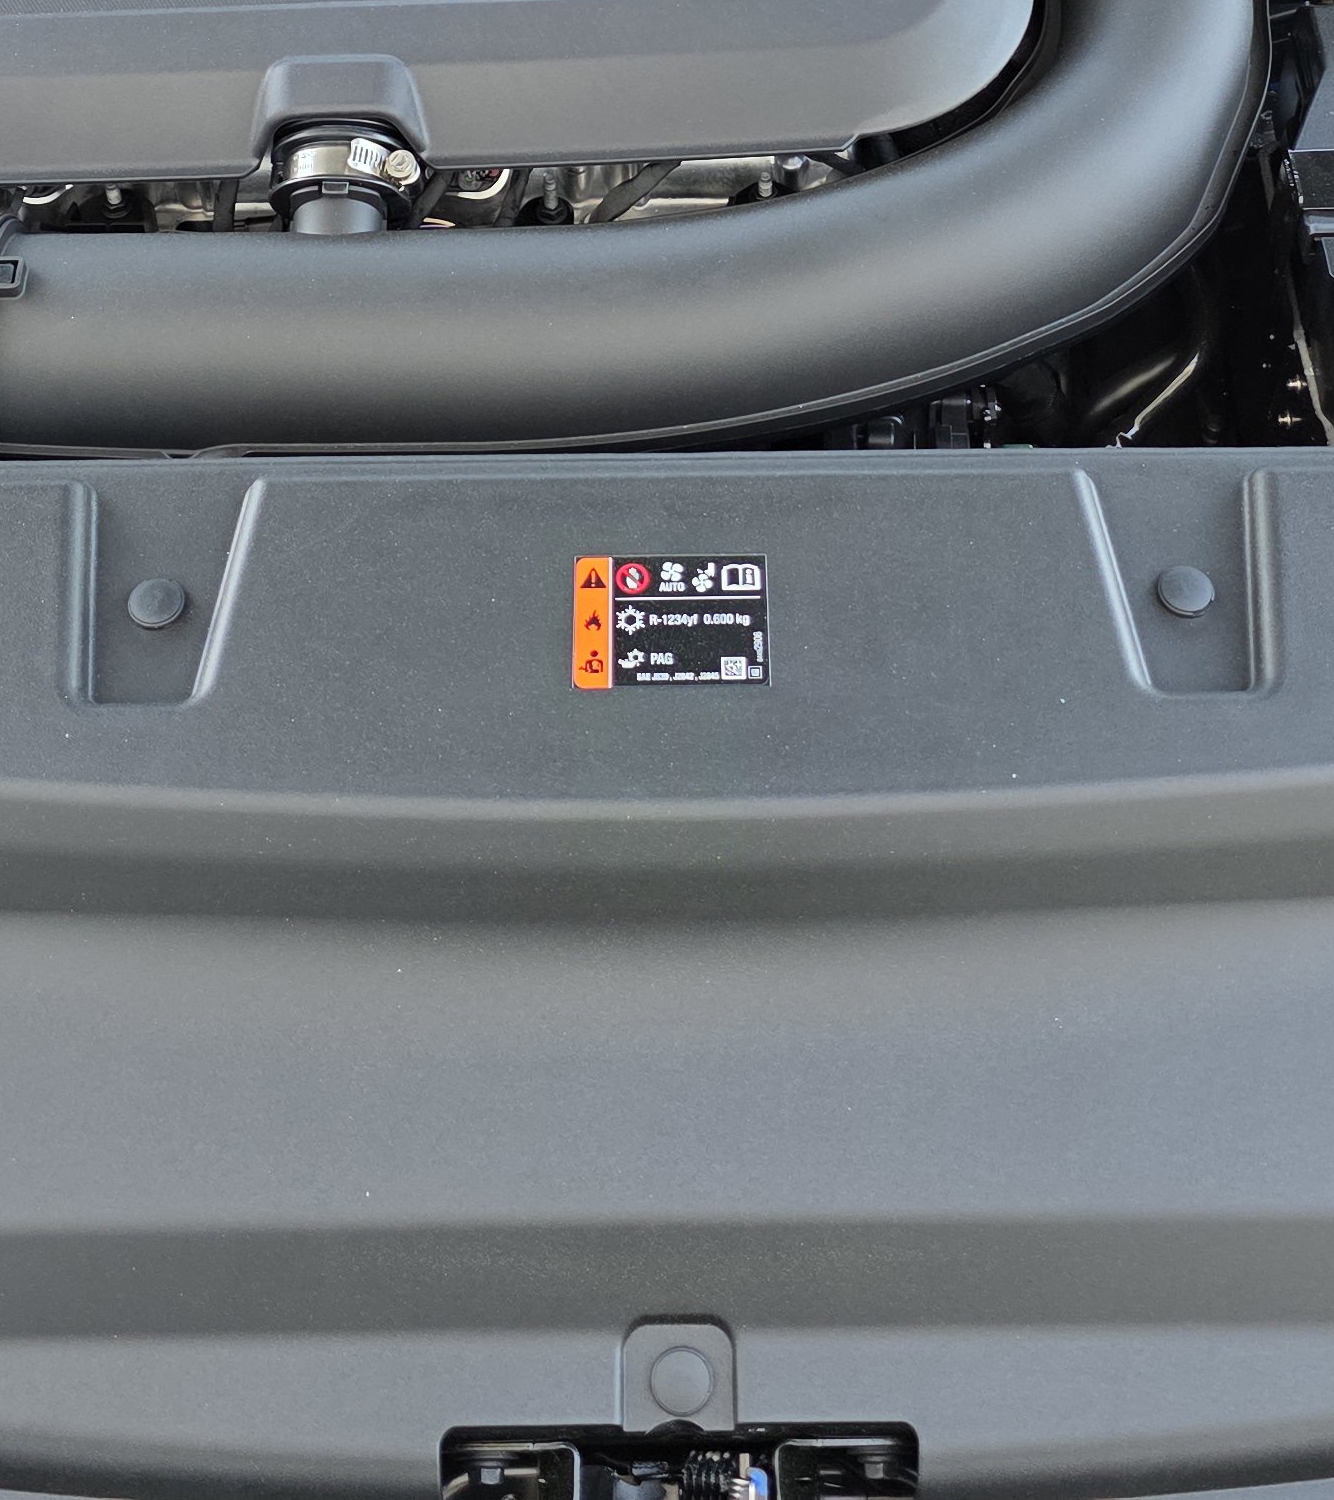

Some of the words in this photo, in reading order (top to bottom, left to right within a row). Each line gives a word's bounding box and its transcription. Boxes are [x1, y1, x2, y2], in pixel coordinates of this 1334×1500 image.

[659, 582, 685, 592] AUTO
[649, 613, 698, 627] R-1234yf
[735, 613, 751, 627] kg
[650, 652, 673, 665] PAG
